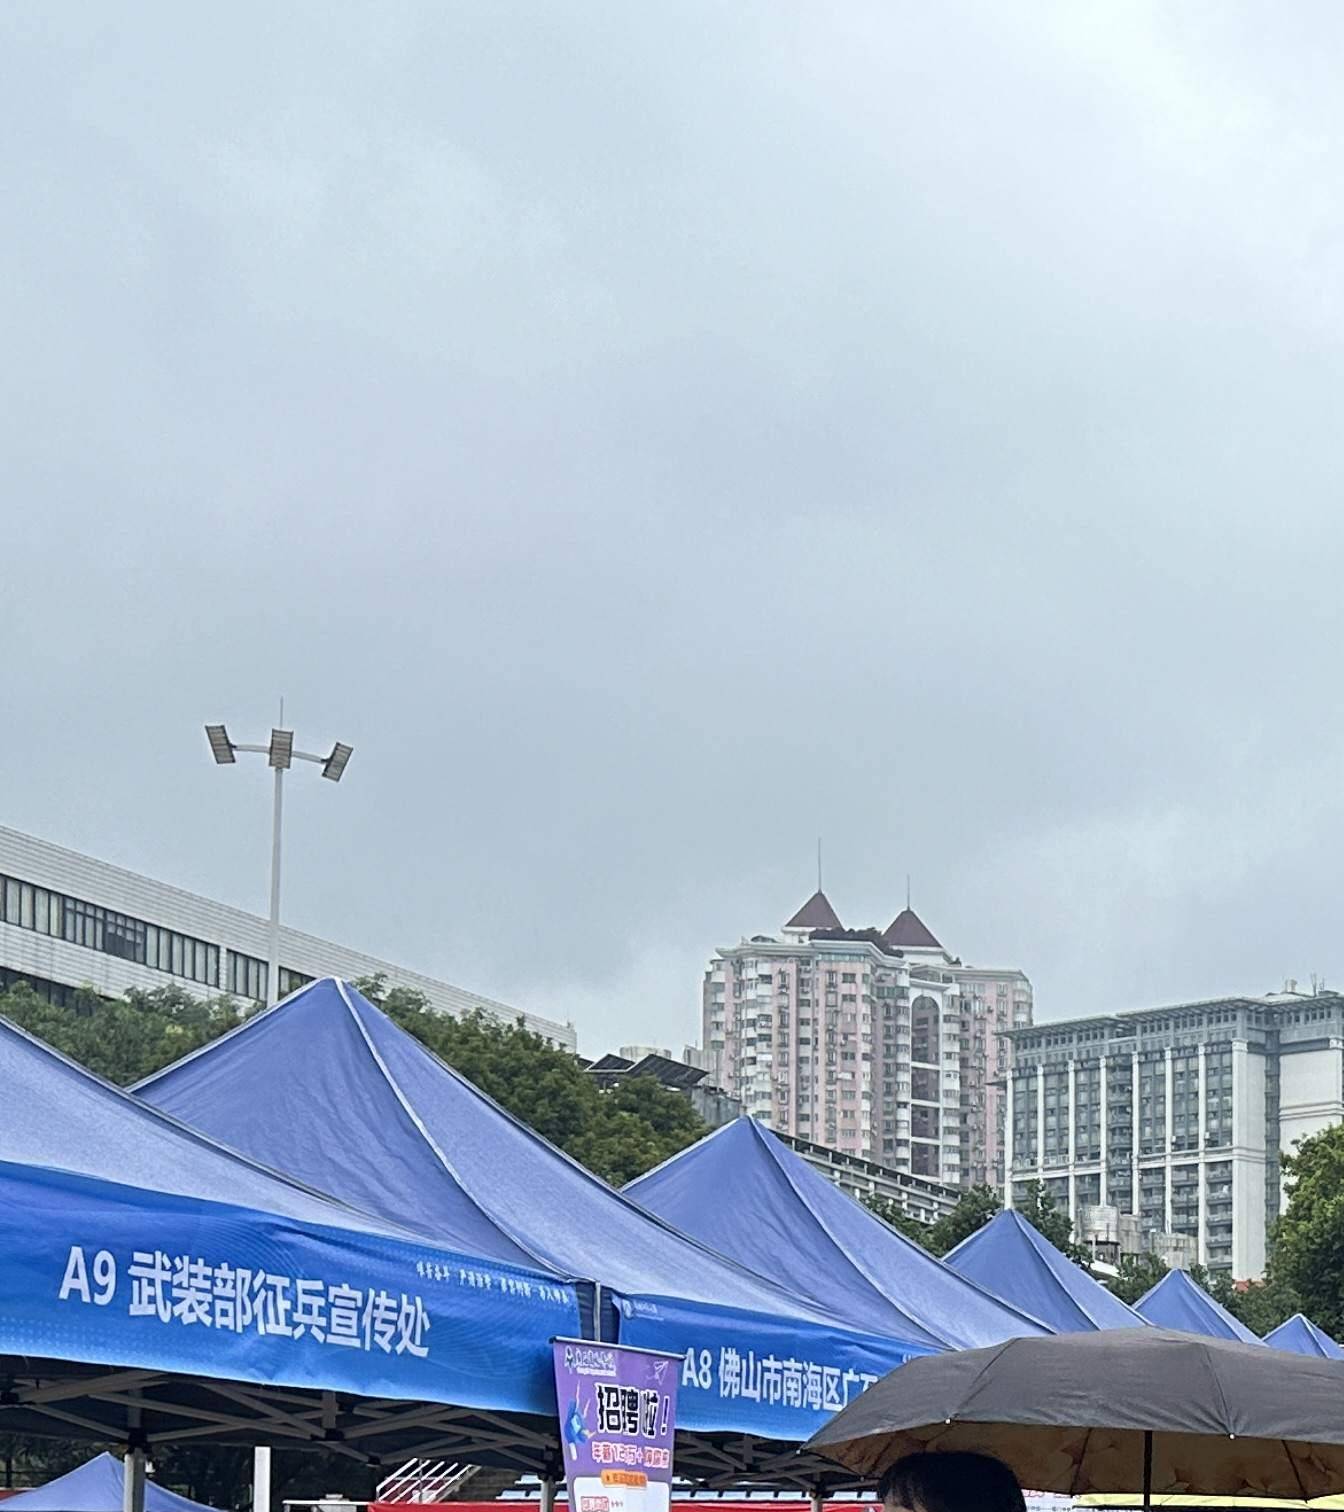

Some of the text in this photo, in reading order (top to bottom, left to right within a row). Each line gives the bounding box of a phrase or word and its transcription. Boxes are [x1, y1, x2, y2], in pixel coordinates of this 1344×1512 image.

[59, 1245, 117, 1305] A9
[128, 1251, 431, 1357] 武装部征兵宣传处
[682, 1347, 713, 1389] A8
